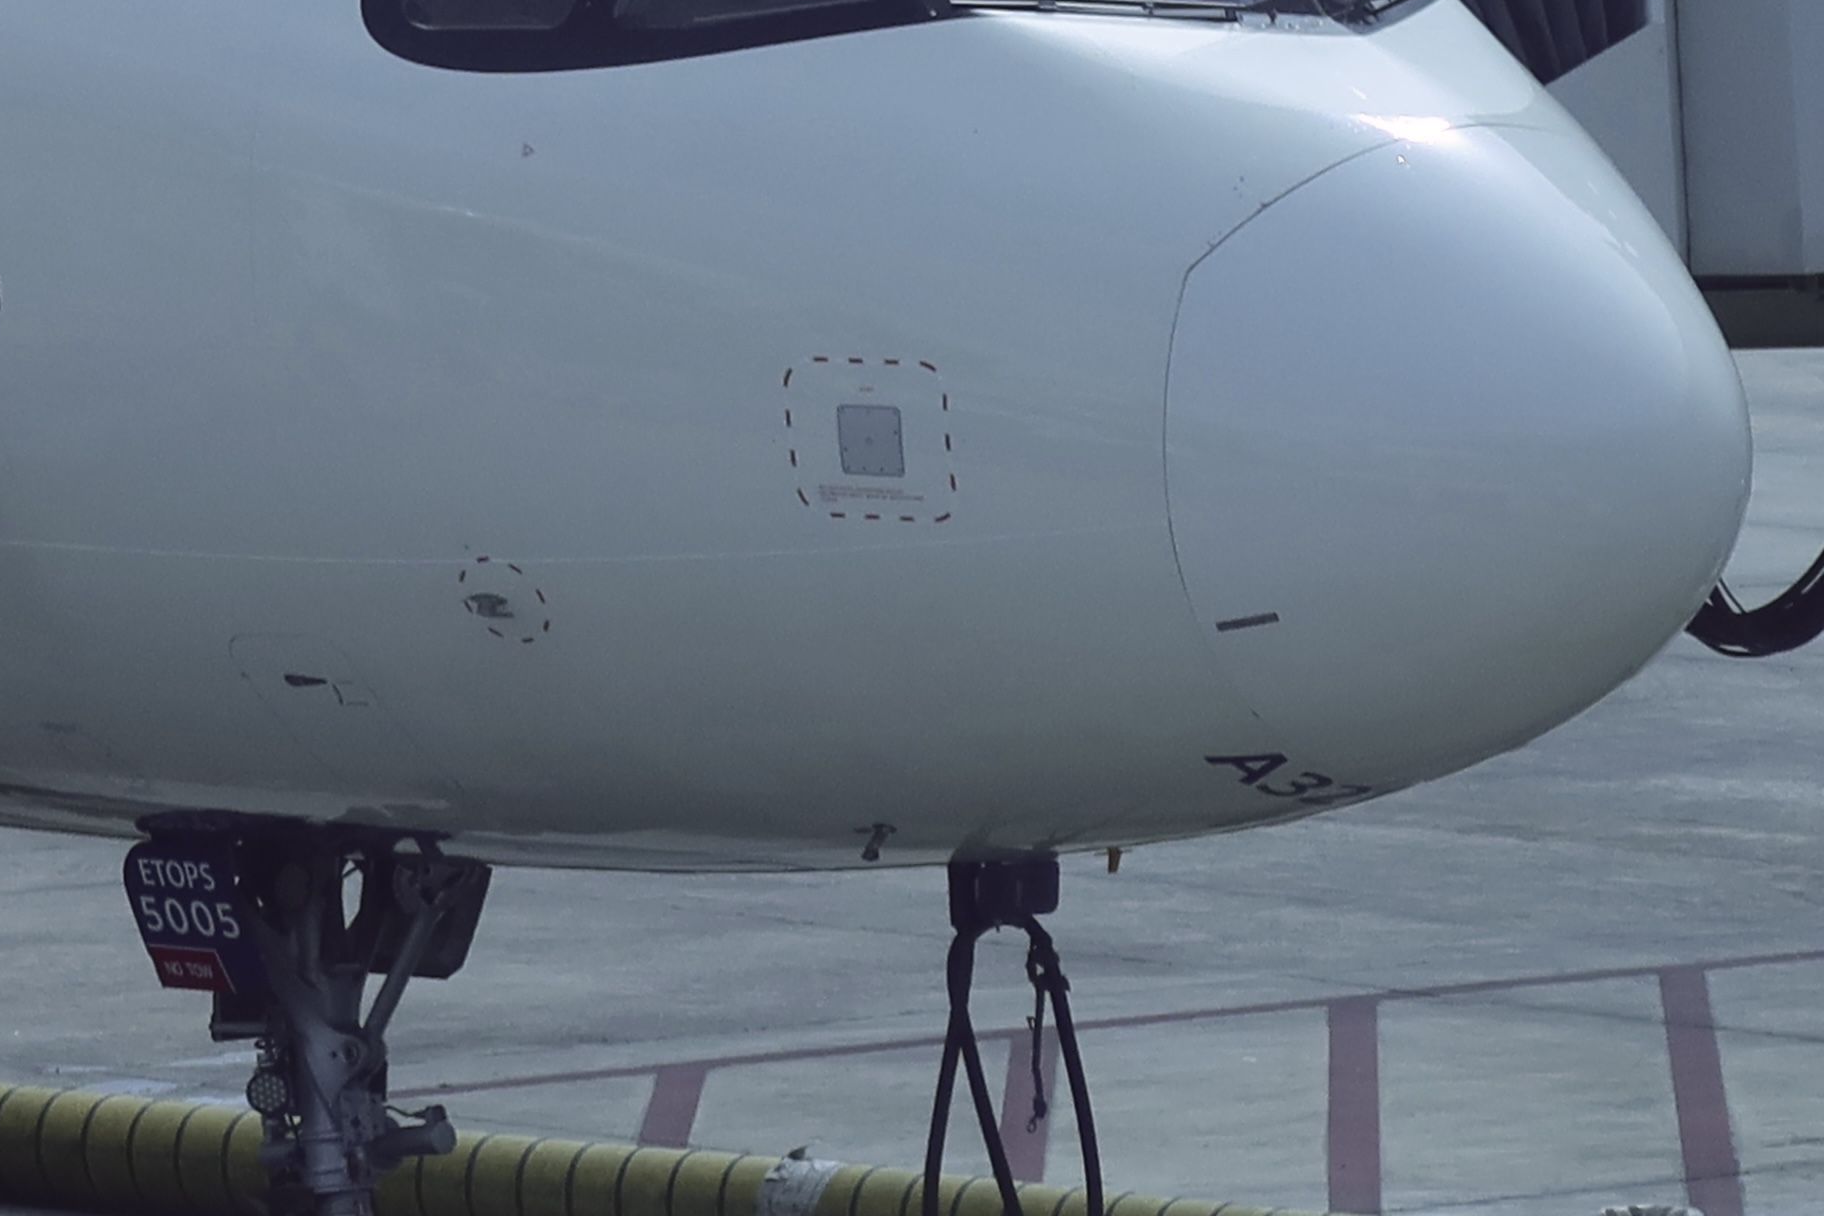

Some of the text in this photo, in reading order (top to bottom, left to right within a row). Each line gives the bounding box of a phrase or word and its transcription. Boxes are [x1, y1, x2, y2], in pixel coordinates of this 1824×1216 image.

[137, 858, 216, 891] ETOPS
[140, 895, 241, 939] 5005
[164, 961, 214, 978] NO TOW
